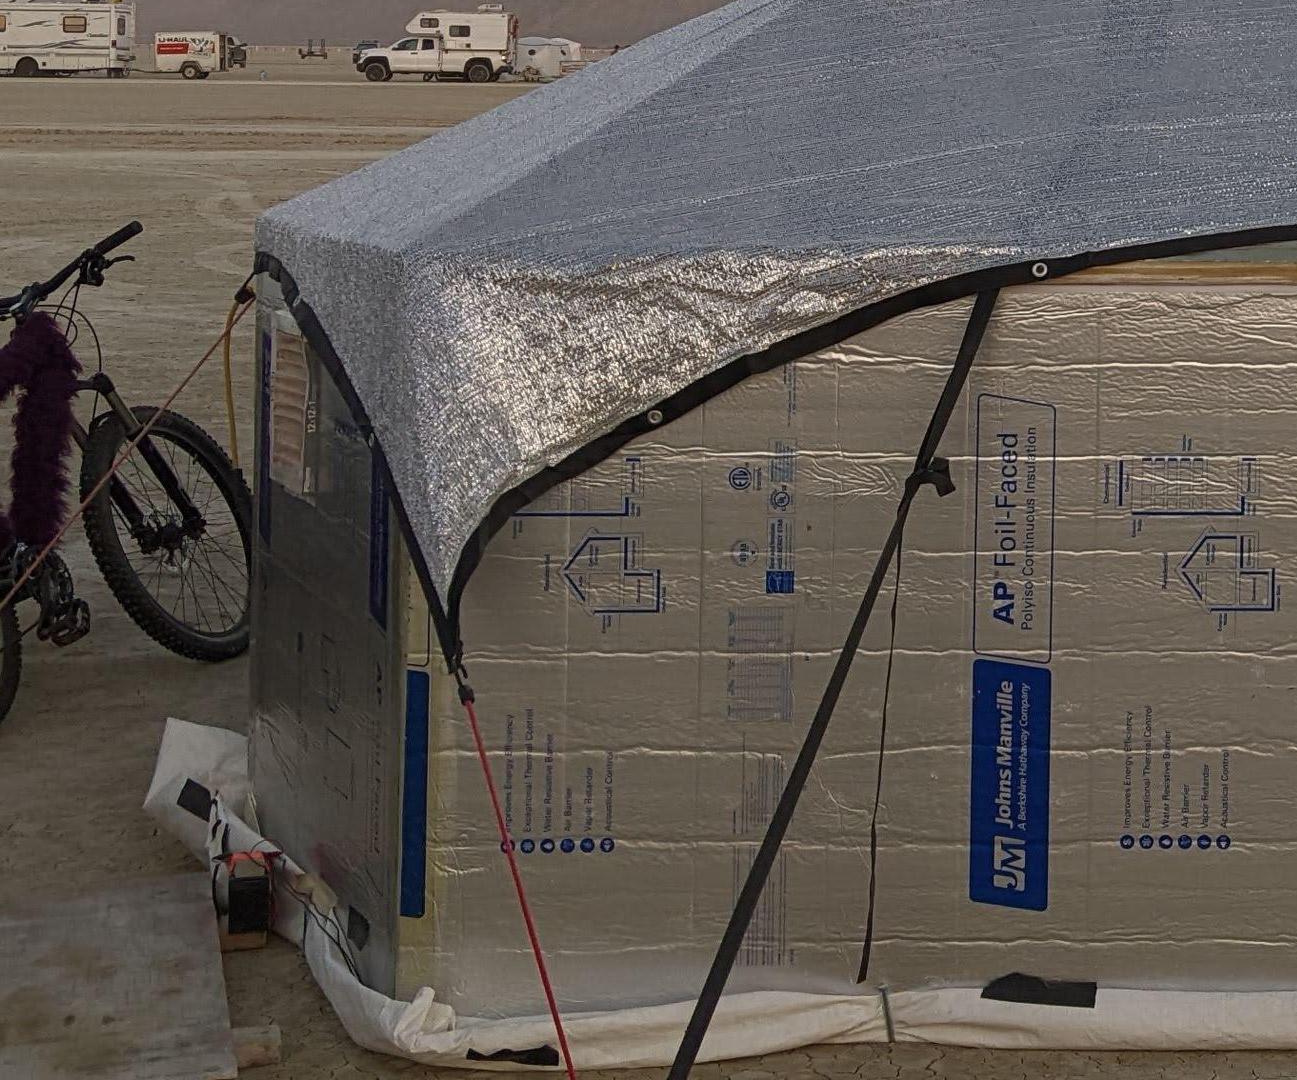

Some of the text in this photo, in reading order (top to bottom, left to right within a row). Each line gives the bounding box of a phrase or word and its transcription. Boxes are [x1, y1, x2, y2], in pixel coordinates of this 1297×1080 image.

[993, 433, 1019, 626] AP Foil-Faced
[1021, 427, 1037, 631] Polyiso Continuous Insulation
[524, 709, 535, 741] Control
[995, 680, 1014, 829] Johns Manville
[604, 751, 613, 784] Control
[1018, 682, 1031, 832] A Berkshire Hathaway Company
[1123, 711, 1134, 828] Improves Energy Efficiency
[1143, 705, 1153, 829] Exceptional Thermal Control
[1162, 761, 1171, 801] Resistive
[564, 788, 573, 816] Barrier
[1162, 804, 1171, 828] Water
[1181, 784, 1190, 828] Air Barrier
[1200, 803, 1210, 828] Vapor
[1220, 749, 1230, 829] Acoustical Control
